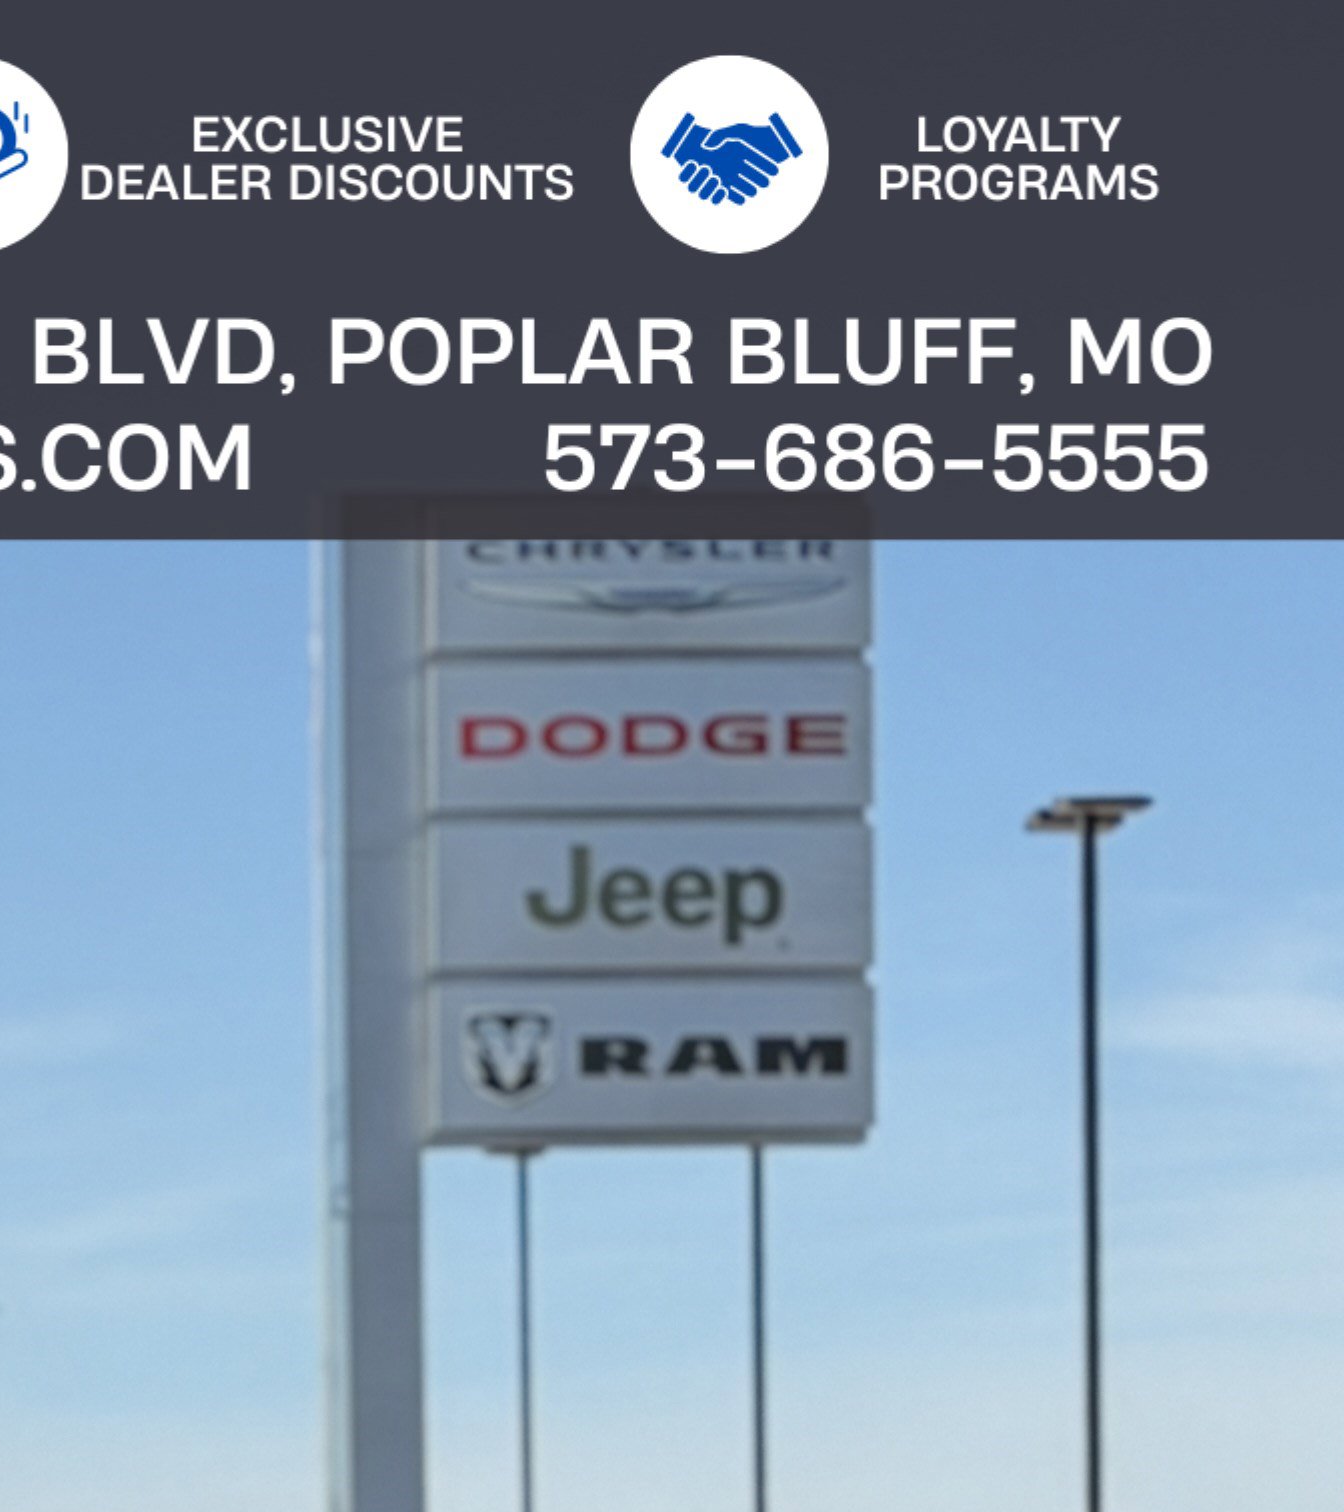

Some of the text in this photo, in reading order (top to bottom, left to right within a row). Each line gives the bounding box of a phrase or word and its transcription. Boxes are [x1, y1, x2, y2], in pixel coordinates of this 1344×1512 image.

[466, 540, 836, 564] CHRYSLER
[458, 713, 848, 760] DODGE
[525, 844, 784, 947] Jeep
[577, 1035, 850, 1077] RAM
